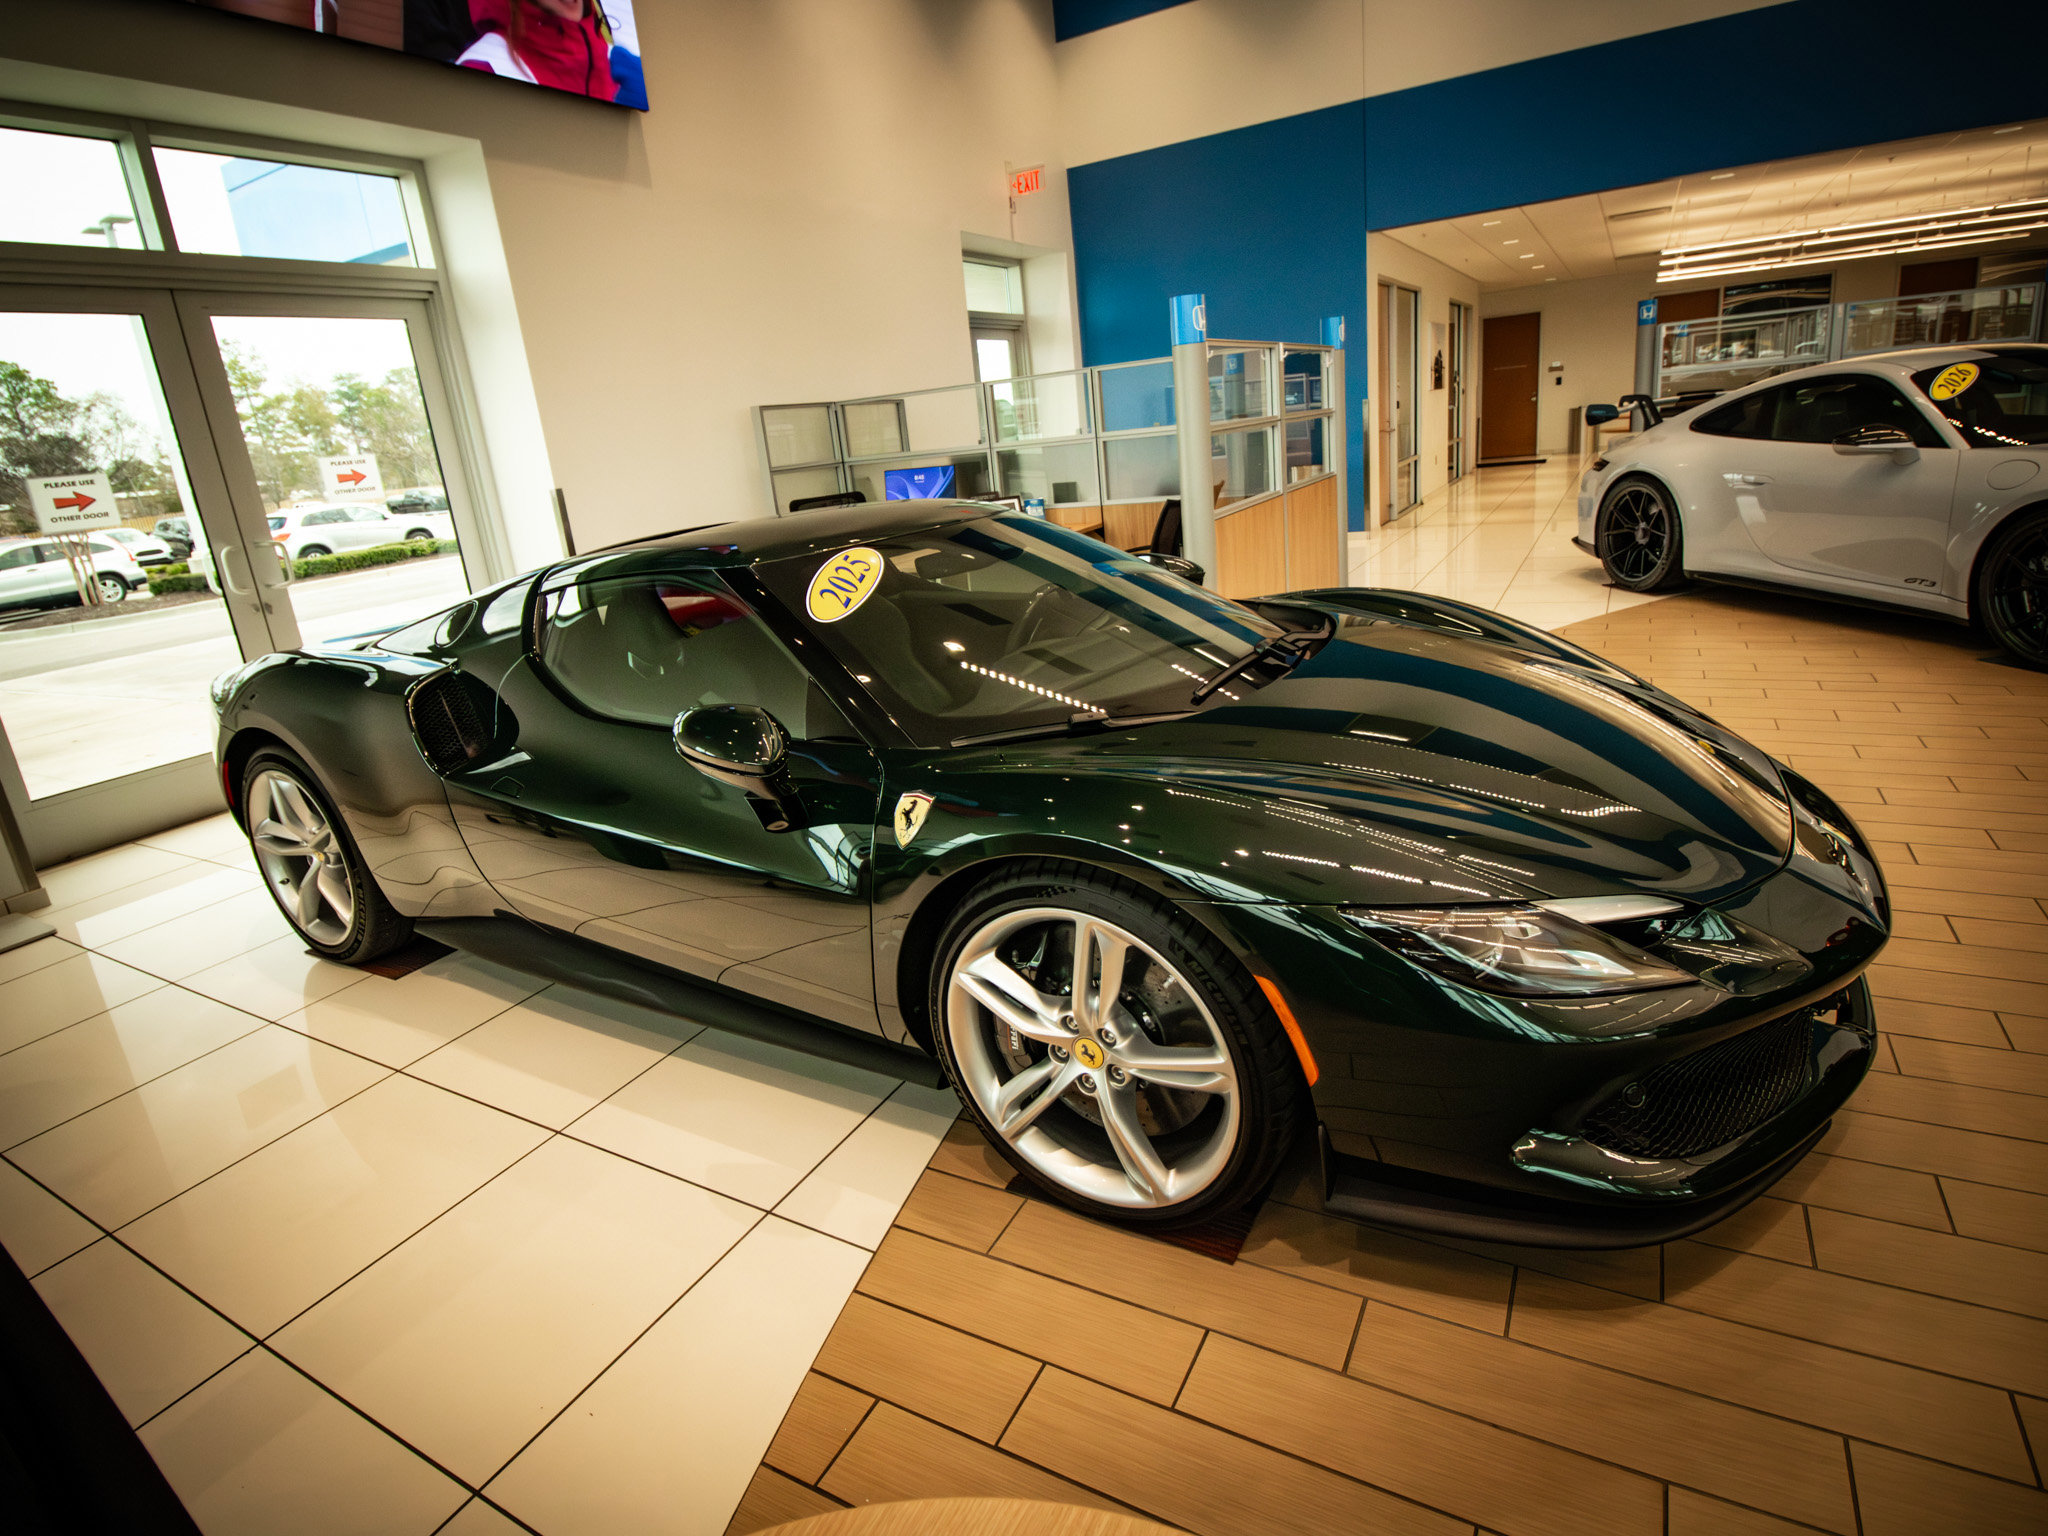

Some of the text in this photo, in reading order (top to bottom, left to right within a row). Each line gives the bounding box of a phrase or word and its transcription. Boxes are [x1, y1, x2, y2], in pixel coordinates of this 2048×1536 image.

[1016, 169, 1040, 194] EXIT
[1937, 366, 1972, 394] 2026
[43, 480, 77, 489] PLEASE
[50, 511, 110, 523] OTHER DOOR
[819, 554, 871, 609] 2025
[1903, 577, 1937, 588] GT3
[1187, 960, 1249, 1045] MICHELIN
